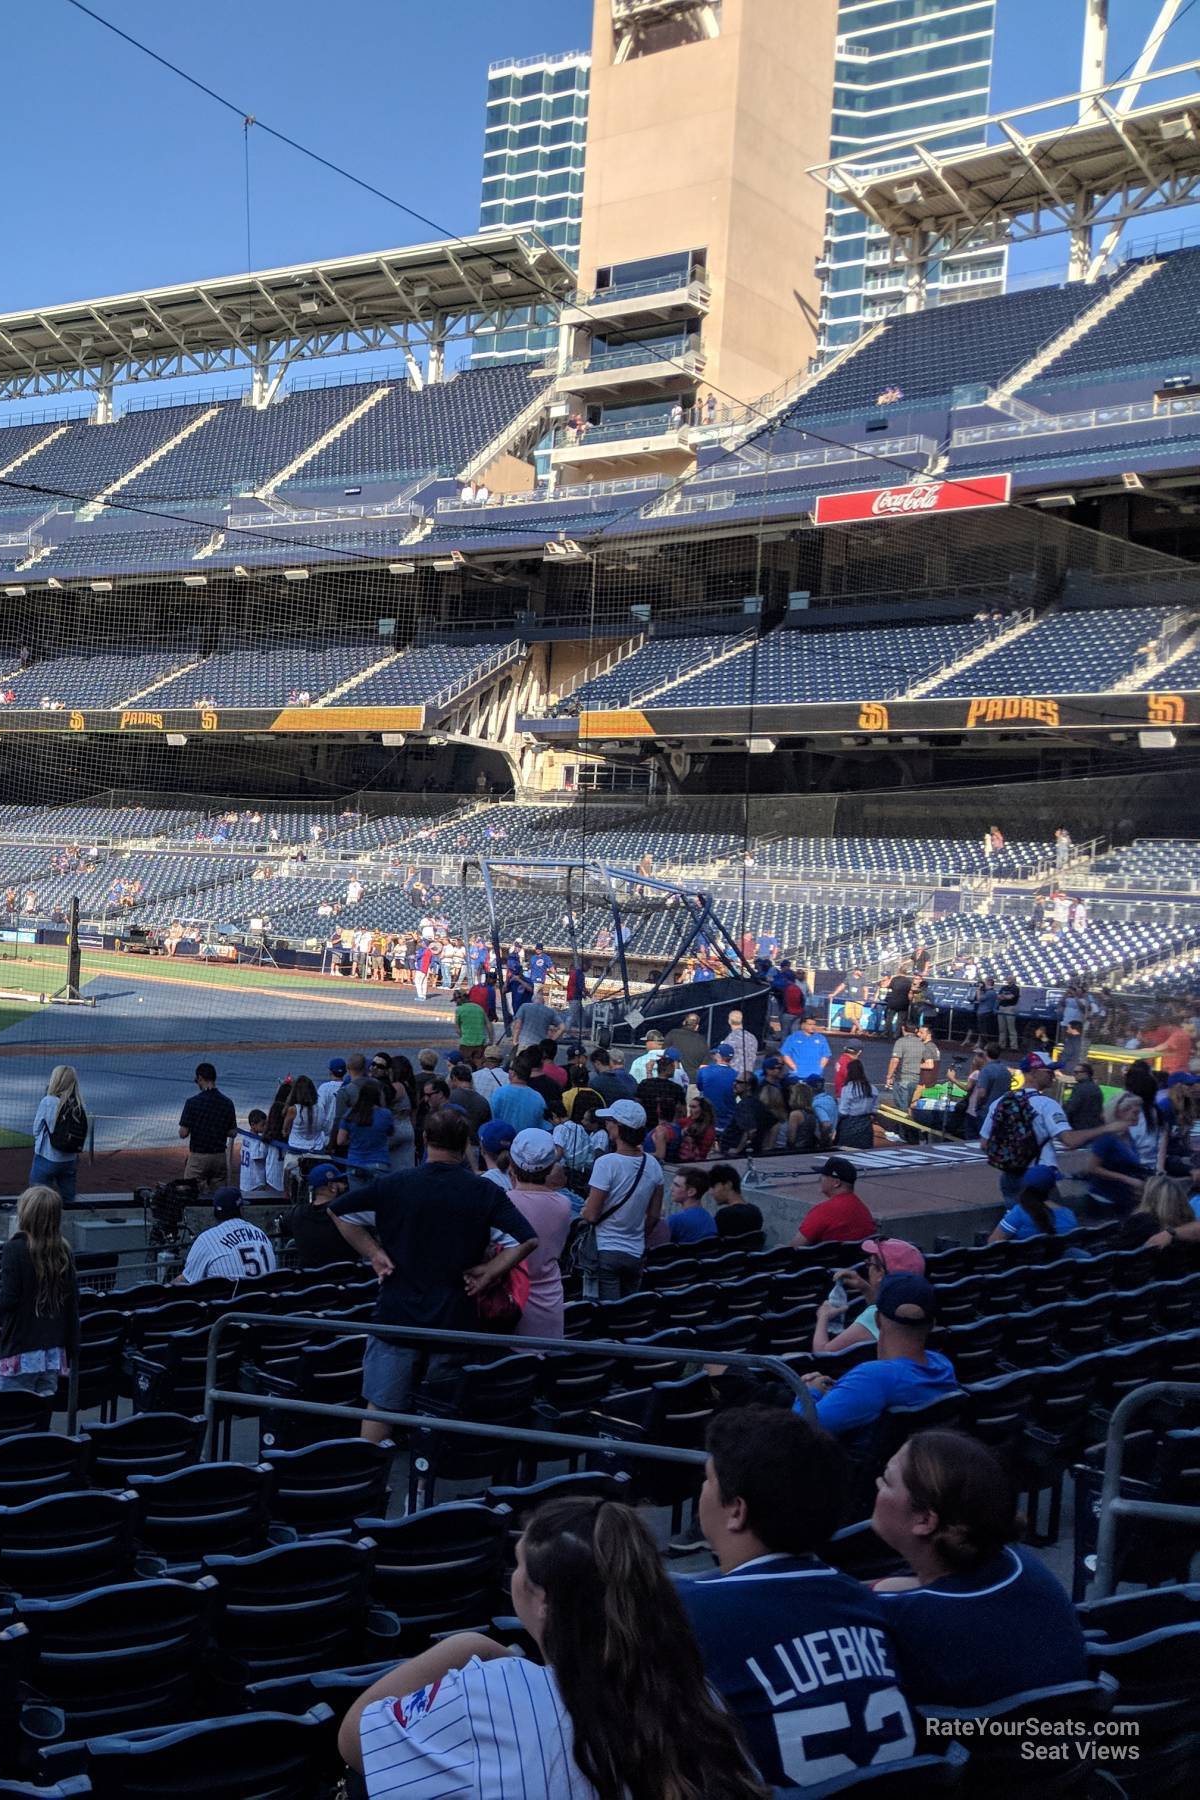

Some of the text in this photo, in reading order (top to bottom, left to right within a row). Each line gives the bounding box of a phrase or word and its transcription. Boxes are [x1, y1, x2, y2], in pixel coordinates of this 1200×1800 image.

[120, 711, 163, 730] PADRES
[967, 697, 1060, 729] PADRES
[220, 1228, 268, 1249] HOFFMAN
[239, 1245, 270, 1277] 51
[746, 1626, 896, 1706] LUEBKE
